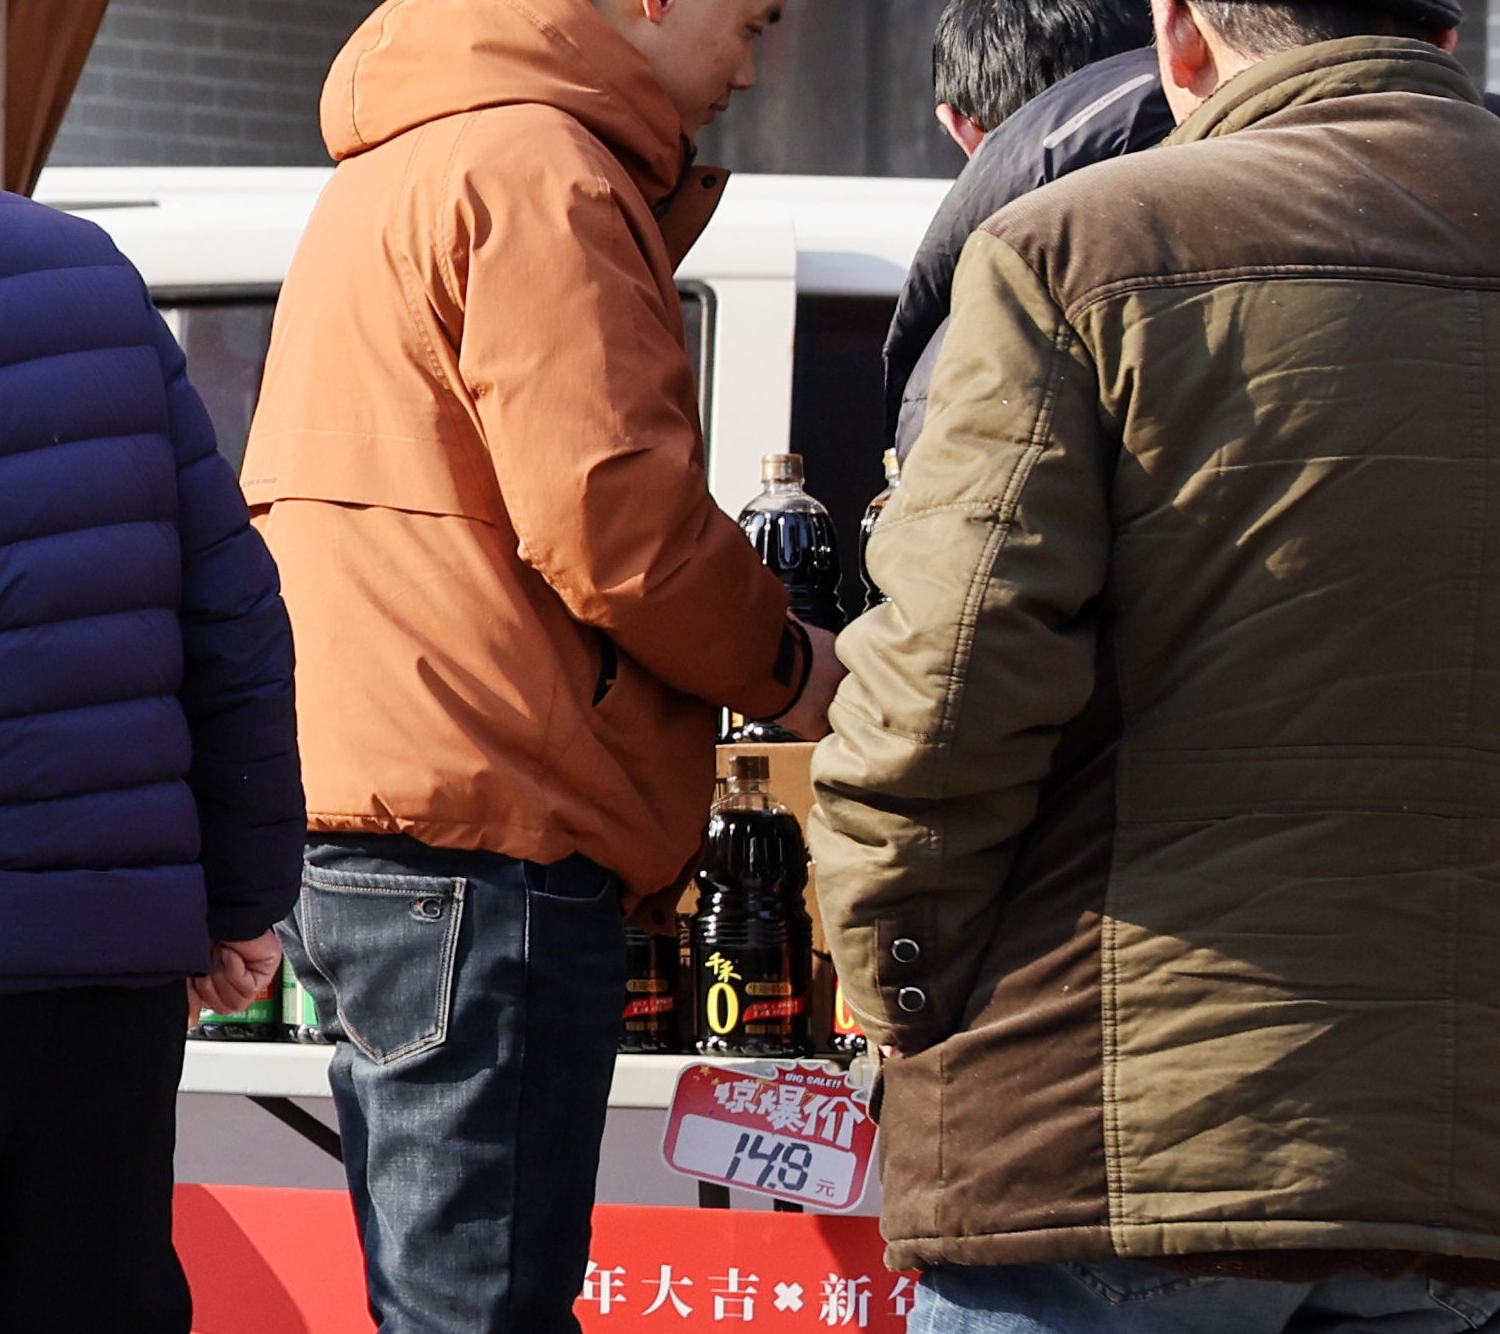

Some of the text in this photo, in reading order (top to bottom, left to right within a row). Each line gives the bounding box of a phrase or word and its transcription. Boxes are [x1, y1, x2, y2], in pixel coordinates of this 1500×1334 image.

[784, 1072, 805, 1083] BIG
[713, 1078, 866, 1149] 惊爆价
[814, 1178, 836, 1198] 元
